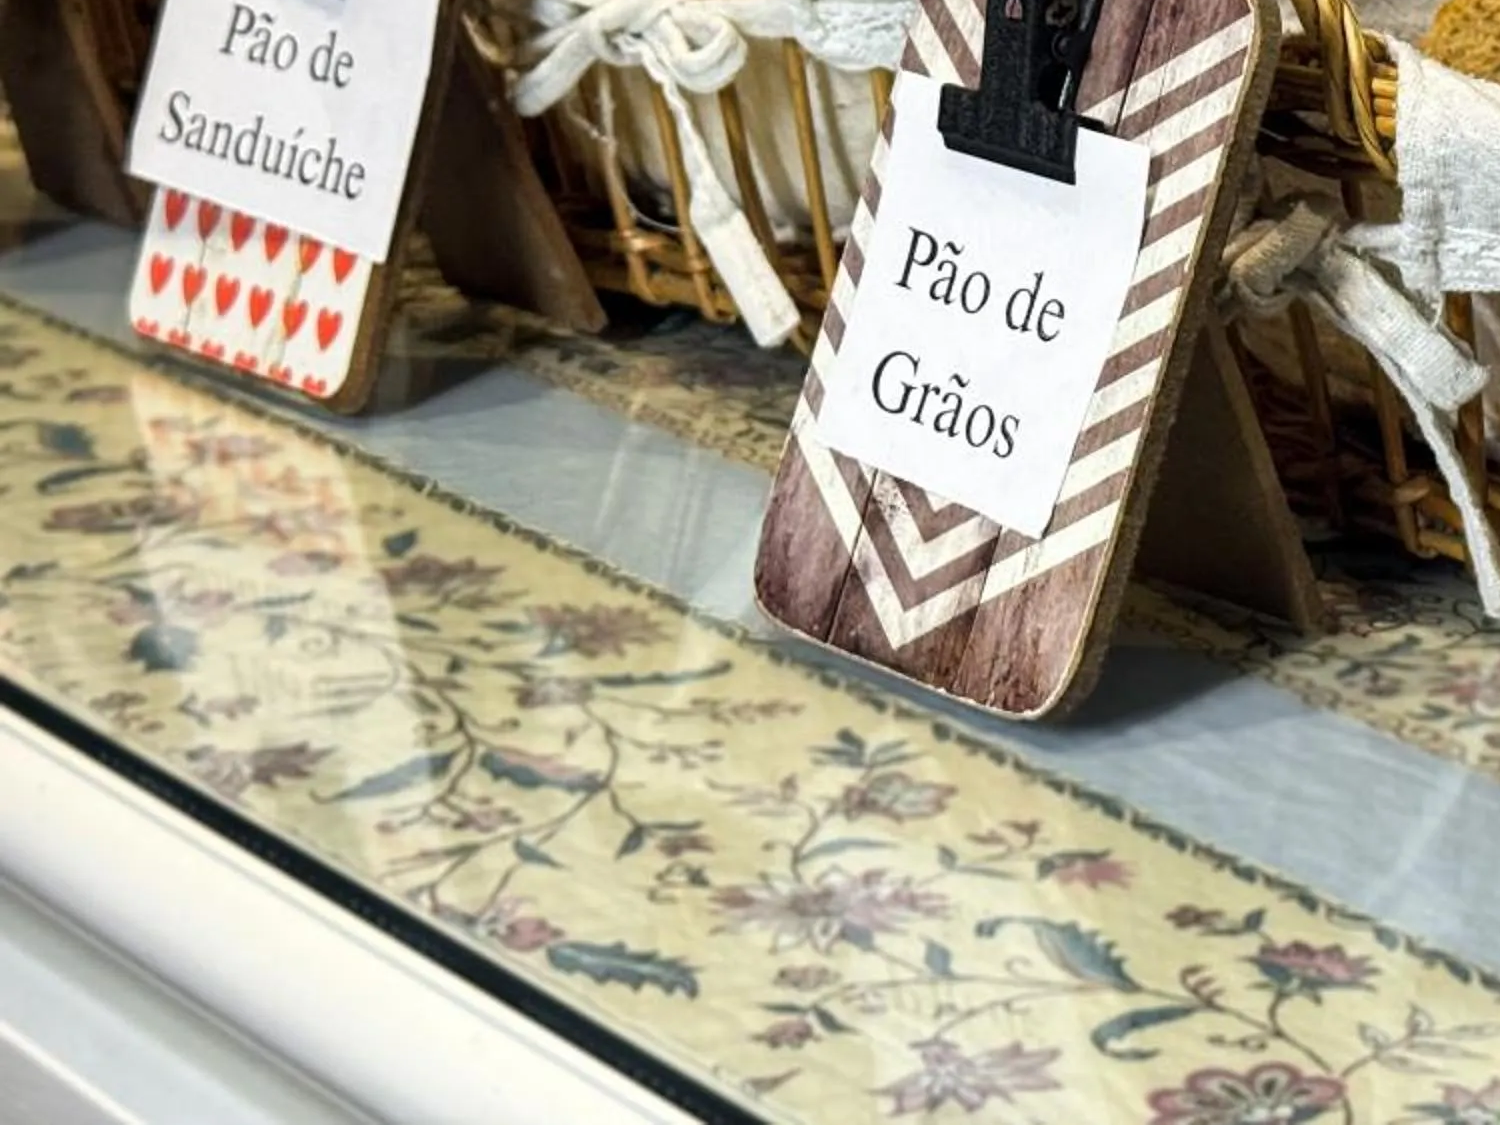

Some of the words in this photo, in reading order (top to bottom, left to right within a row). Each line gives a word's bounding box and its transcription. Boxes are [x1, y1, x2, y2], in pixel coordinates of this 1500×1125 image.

[219, 3, 298, 72] Pão
[309, 29, 355, 89] de
[159, 90, 366, 201] Sanduíche
[894, 227, 990, 315] Pão
[1004, 271, 1066, 343] de
[871, 350, 1021, 459] Grãos
